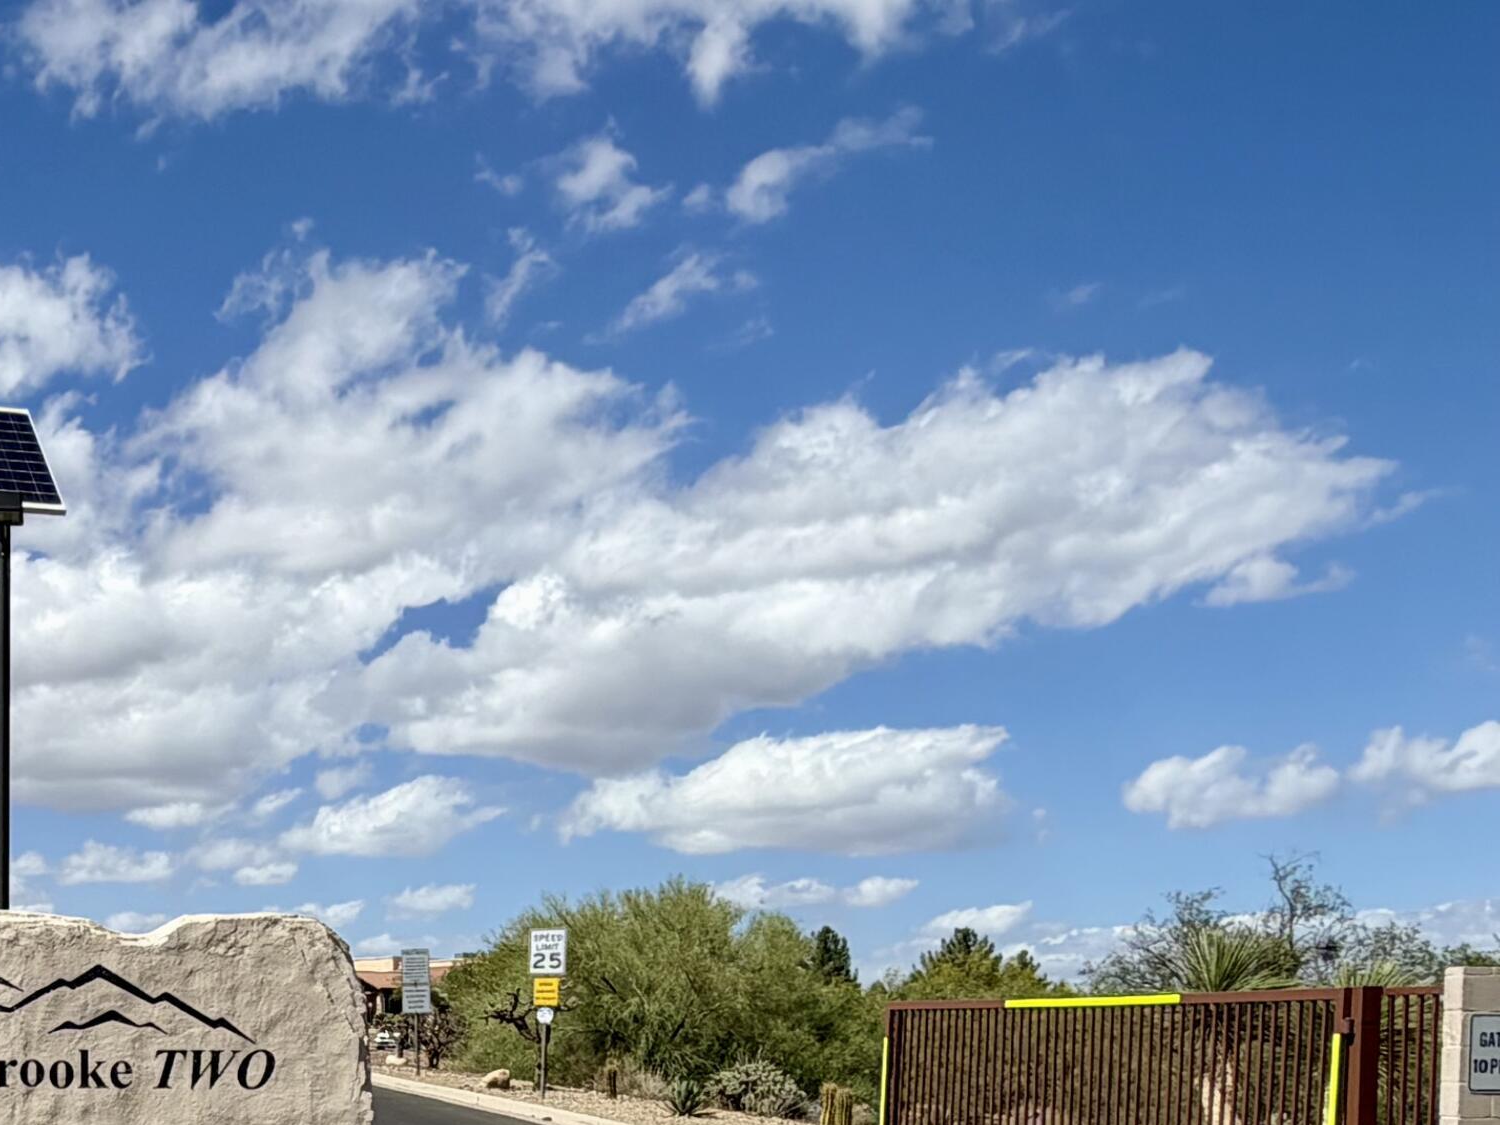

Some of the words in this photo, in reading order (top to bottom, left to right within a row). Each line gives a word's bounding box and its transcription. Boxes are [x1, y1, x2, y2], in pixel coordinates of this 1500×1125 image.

[533, 934, 563, 942] SPEED
[535, 943, 559, 952] LIMIT
[533, 953, 562, 969] 25
[155, 1049, 276, 1090] TWO
[1473, 1058, 1489, 1074] 10
